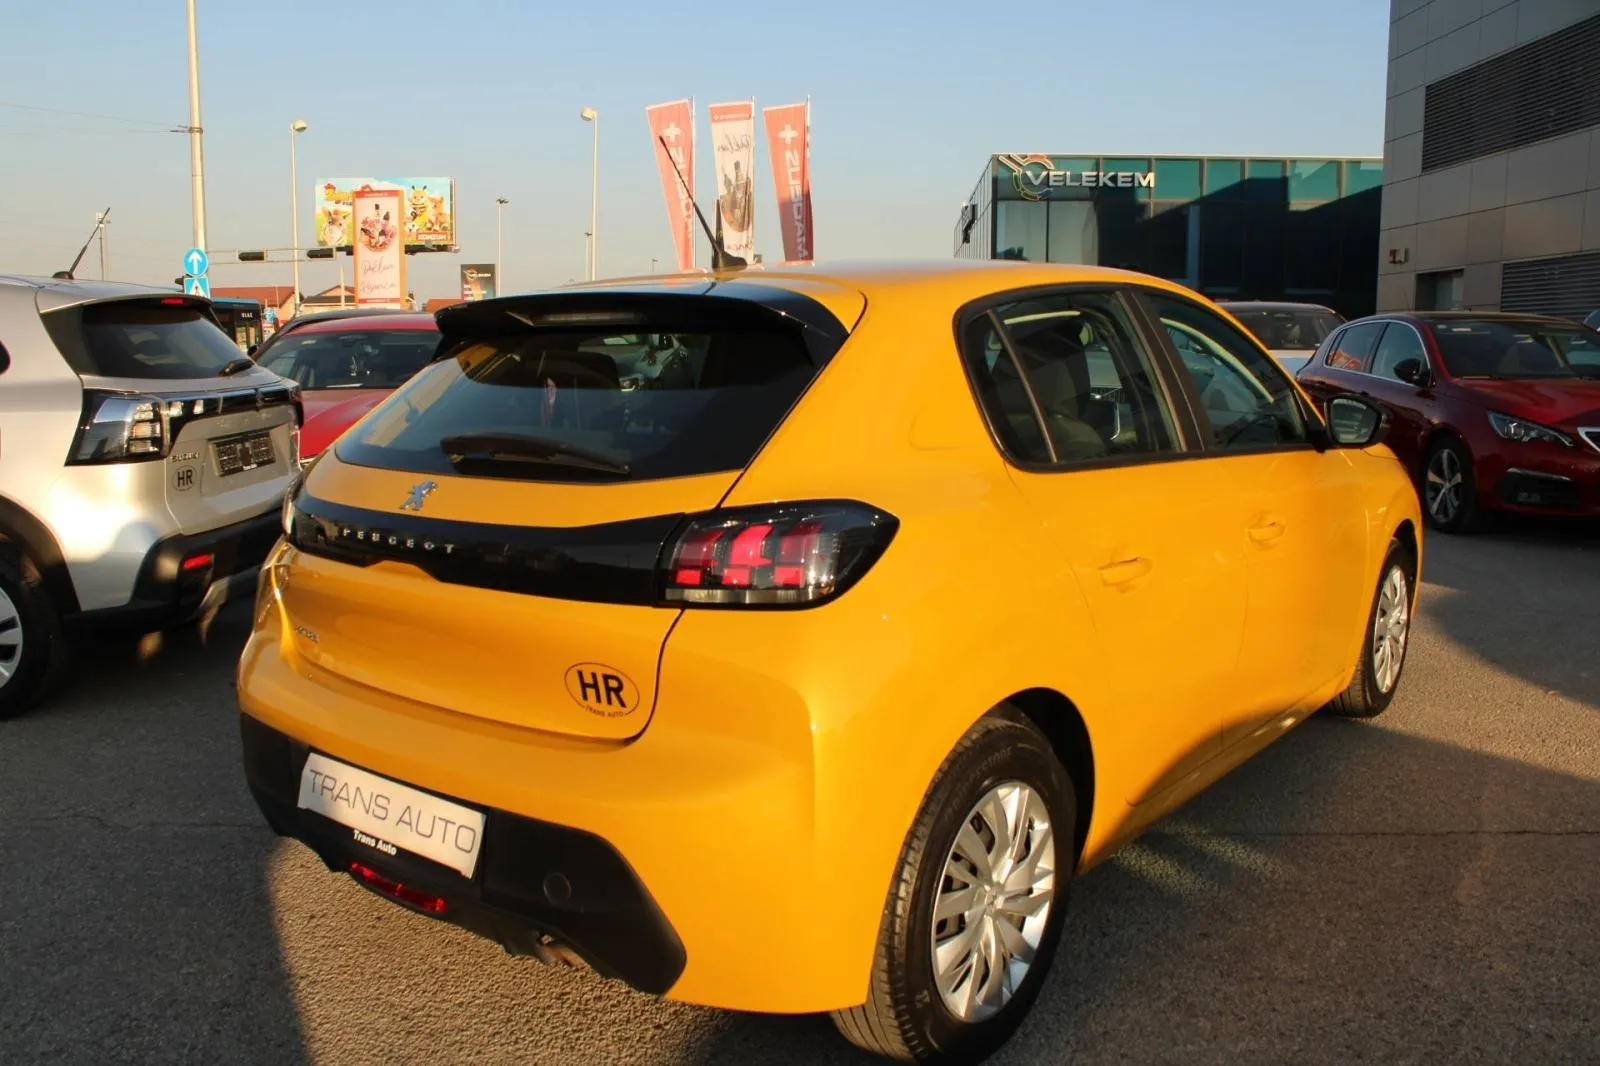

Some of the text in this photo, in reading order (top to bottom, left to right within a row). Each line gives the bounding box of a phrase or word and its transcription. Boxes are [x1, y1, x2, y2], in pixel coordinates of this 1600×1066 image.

[1025, 170, 1155, 188] VELEKEM
[177, 469, 193, 488] HR
[343, 528, 454, 554] PEUGEOT
[577, 669, 627, 708] HR
[309, 769, 476, 854] TRANS AUTO
[353, 829, 397, 856] Trans Auto
